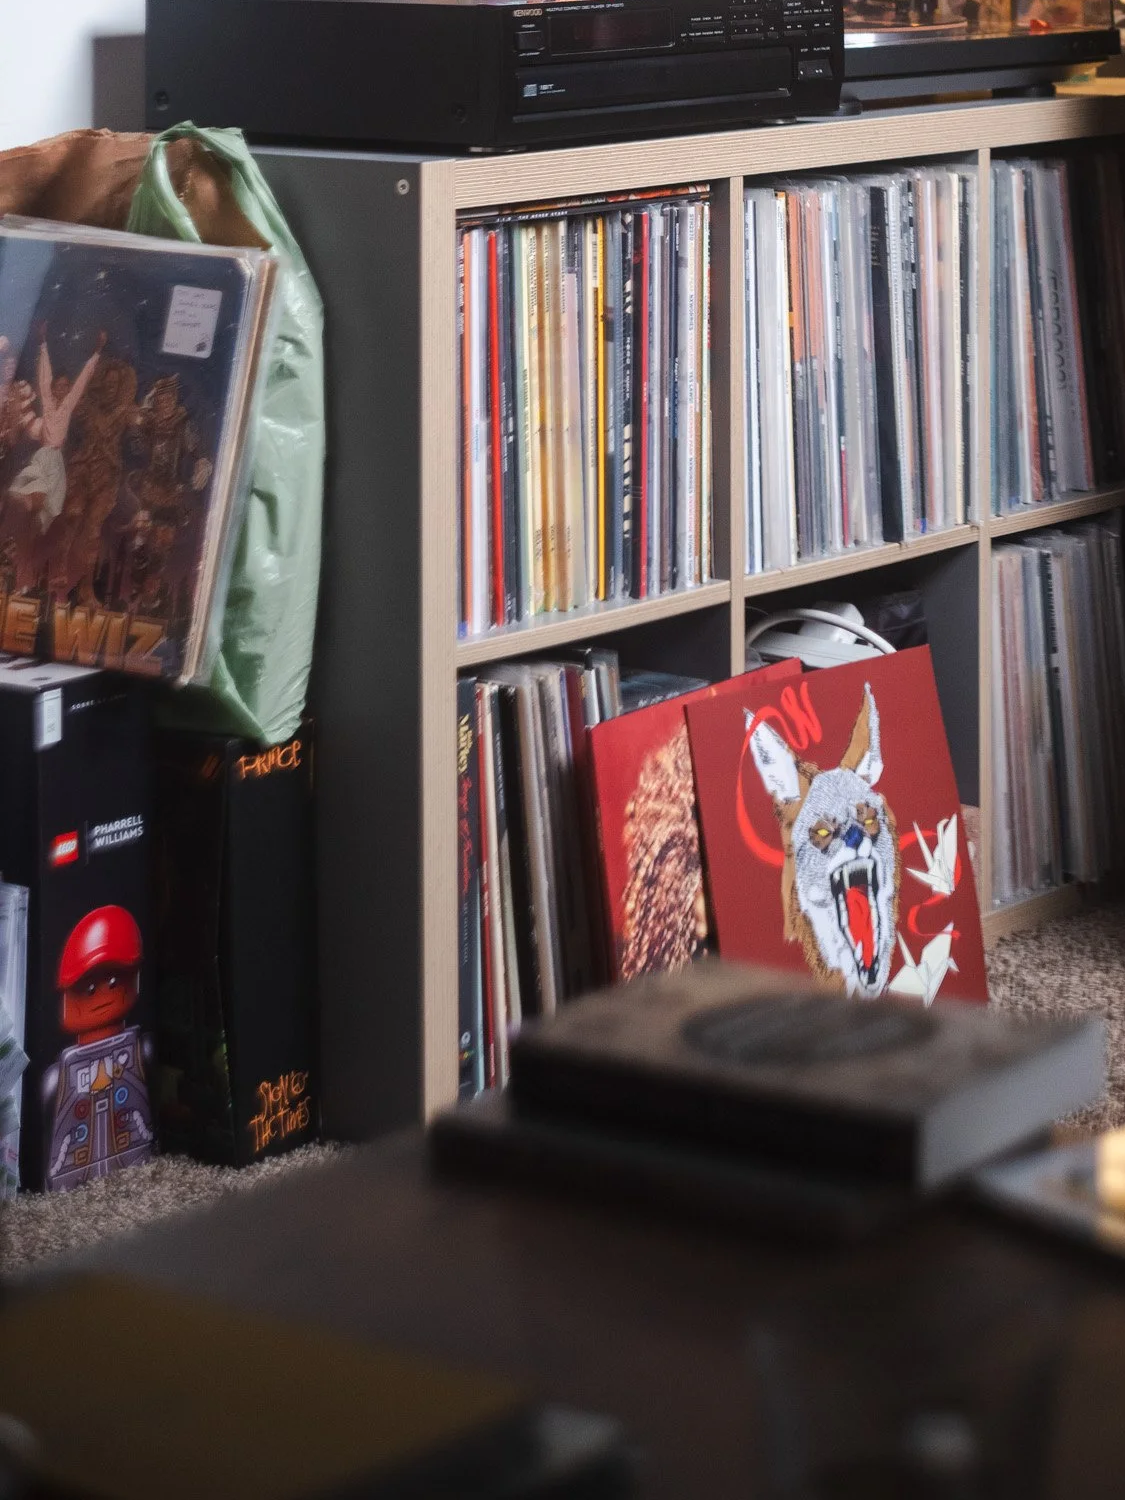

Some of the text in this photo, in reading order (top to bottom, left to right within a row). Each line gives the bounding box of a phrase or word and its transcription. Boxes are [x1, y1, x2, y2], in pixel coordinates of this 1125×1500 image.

[512, 8, 543, 17] KENWOOD
[53, 601, 170, 678] WIZ
[239, 739, 302, 779] PRINCE
[93, 813, 144, 836] PHARRELL
[94, 826, 144, 849] WILLIAMS
